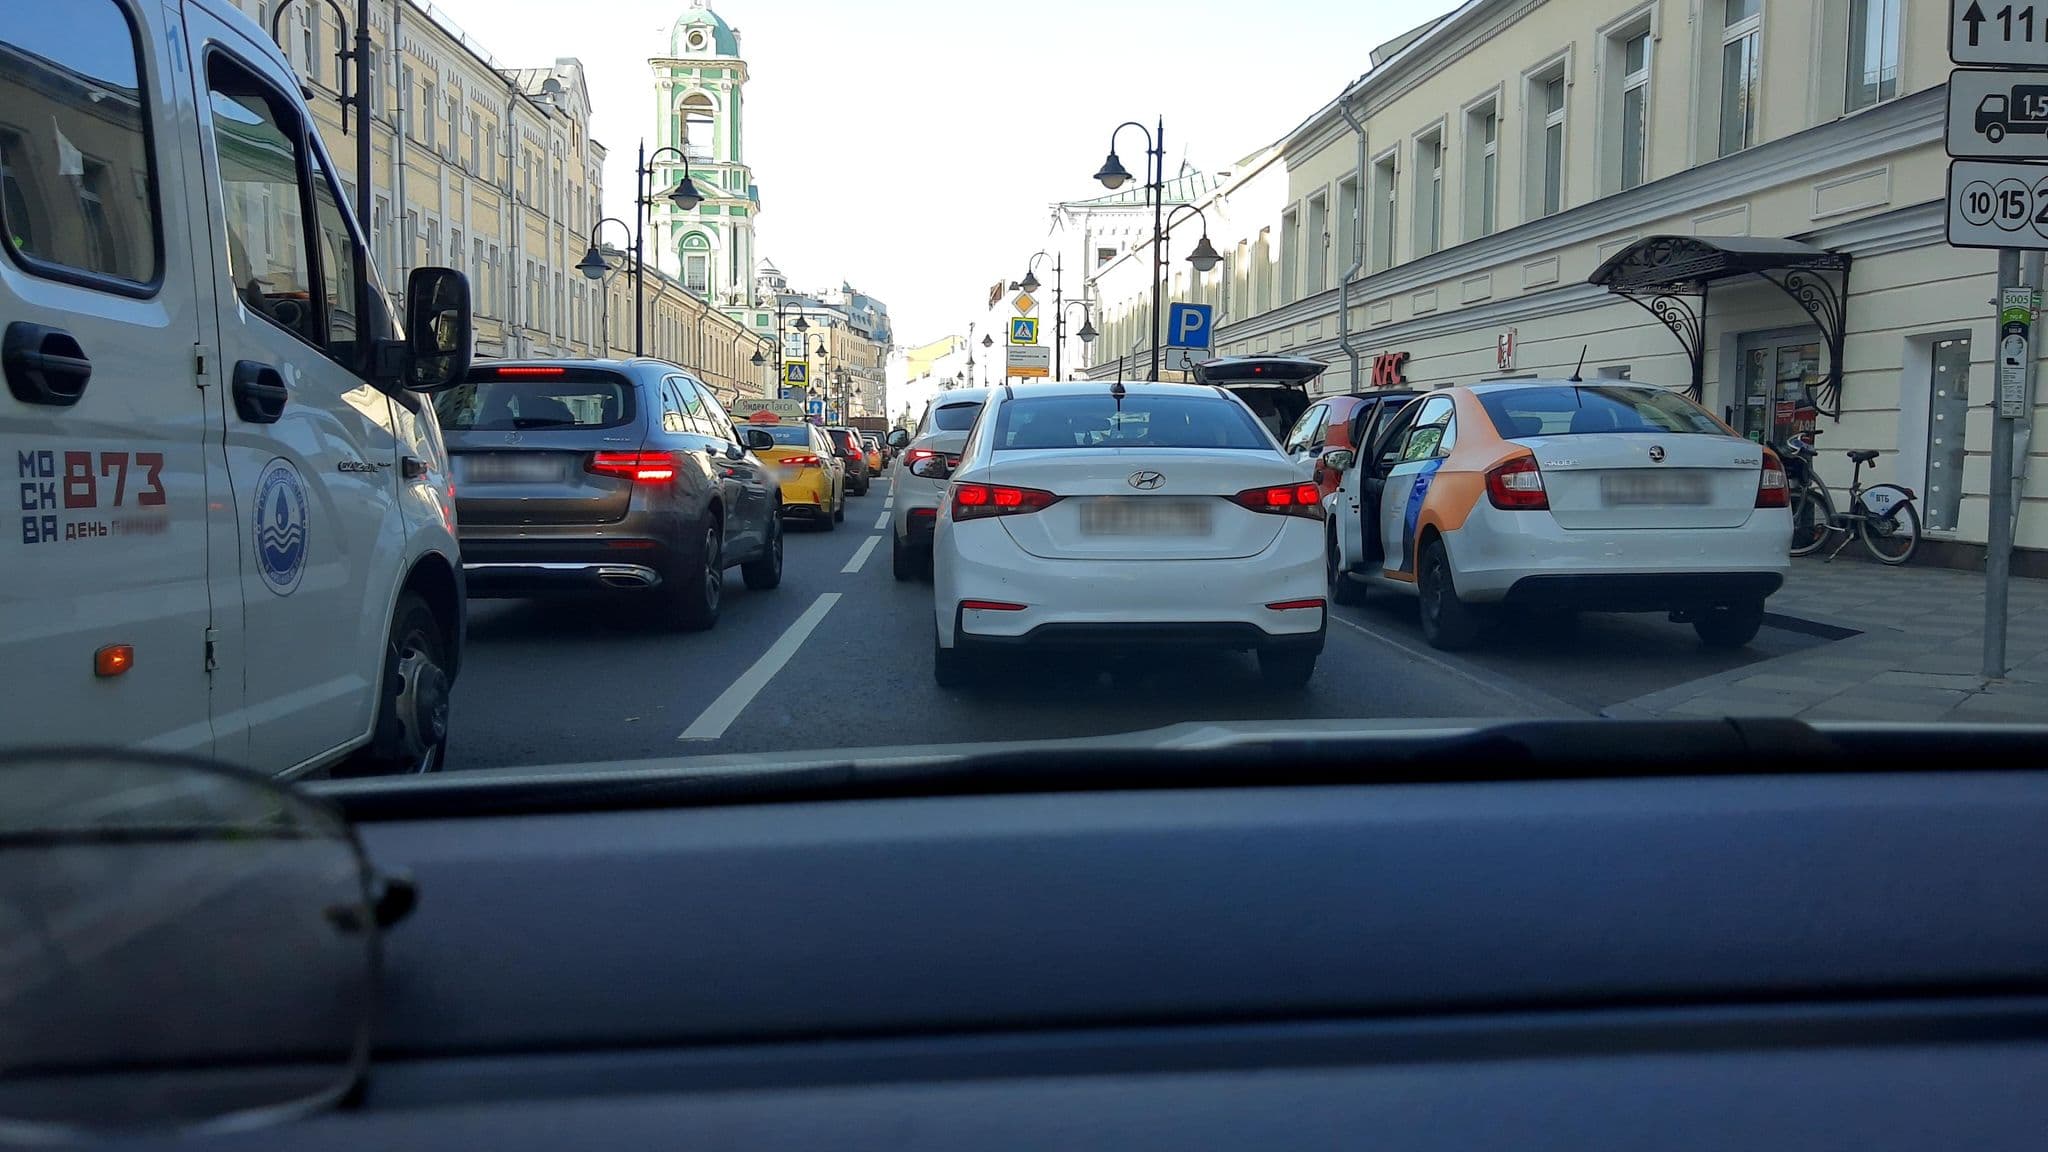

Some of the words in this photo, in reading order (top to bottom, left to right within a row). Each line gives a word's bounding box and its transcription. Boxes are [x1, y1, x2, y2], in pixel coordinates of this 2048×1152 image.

[1997, 5, 2048, 42] 11
[1969, 192, 1990, 214] 10
[1999, 190, 2025, 219] 15
[2004, 295, 2029, 304] 5005
[1180, 309, 1204, 343] P
[1371, 352, 1407, 386] KFC
[18, 450, 55, 478] МО
[63, 451, 166, 509] 873
[20, 482, 57, 510] СК
[1876, 494, 1890, 503] ВТБ
[22, 515, 58, 544] ВА
[65, 521, 108, 541] ДЕНЬ
